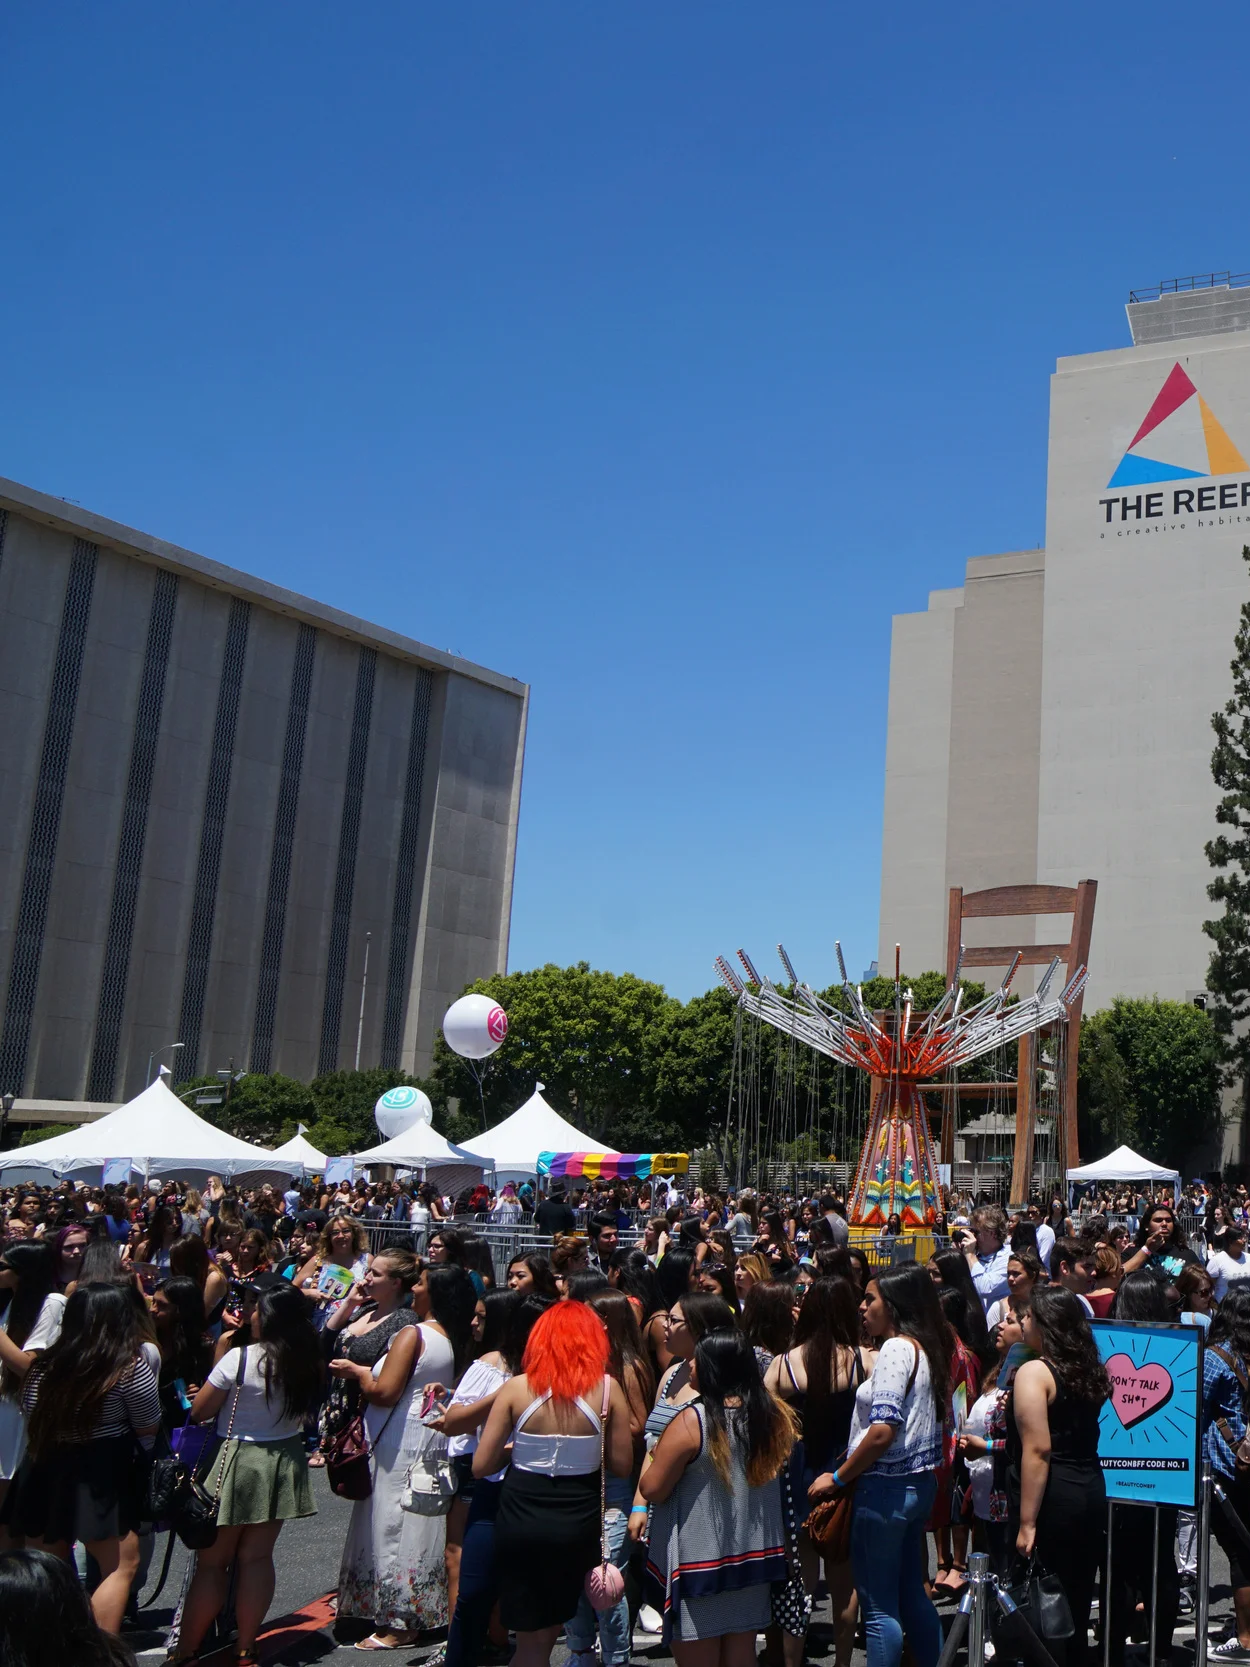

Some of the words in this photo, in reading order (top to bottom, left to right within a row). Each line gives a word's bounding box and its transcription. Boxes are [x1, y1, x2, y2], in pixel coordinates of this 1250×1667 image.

[1099, 492, 1164, 523] THE
[1117, 523, 1186, 537] creative
[1198, 515, 1250, 528] habita
[1110, 1375, 1137, 1388] DON'T
[1139, 1379, 1160, 1391] TALK
[1100, 1459, 1145, 1468] AUTYCONBFF
[1146, 1460, 1166, 1468] CODE
[1167, 1461, 1180, 1469] NO.
[1181, 1461, 1185, 1469] 1
